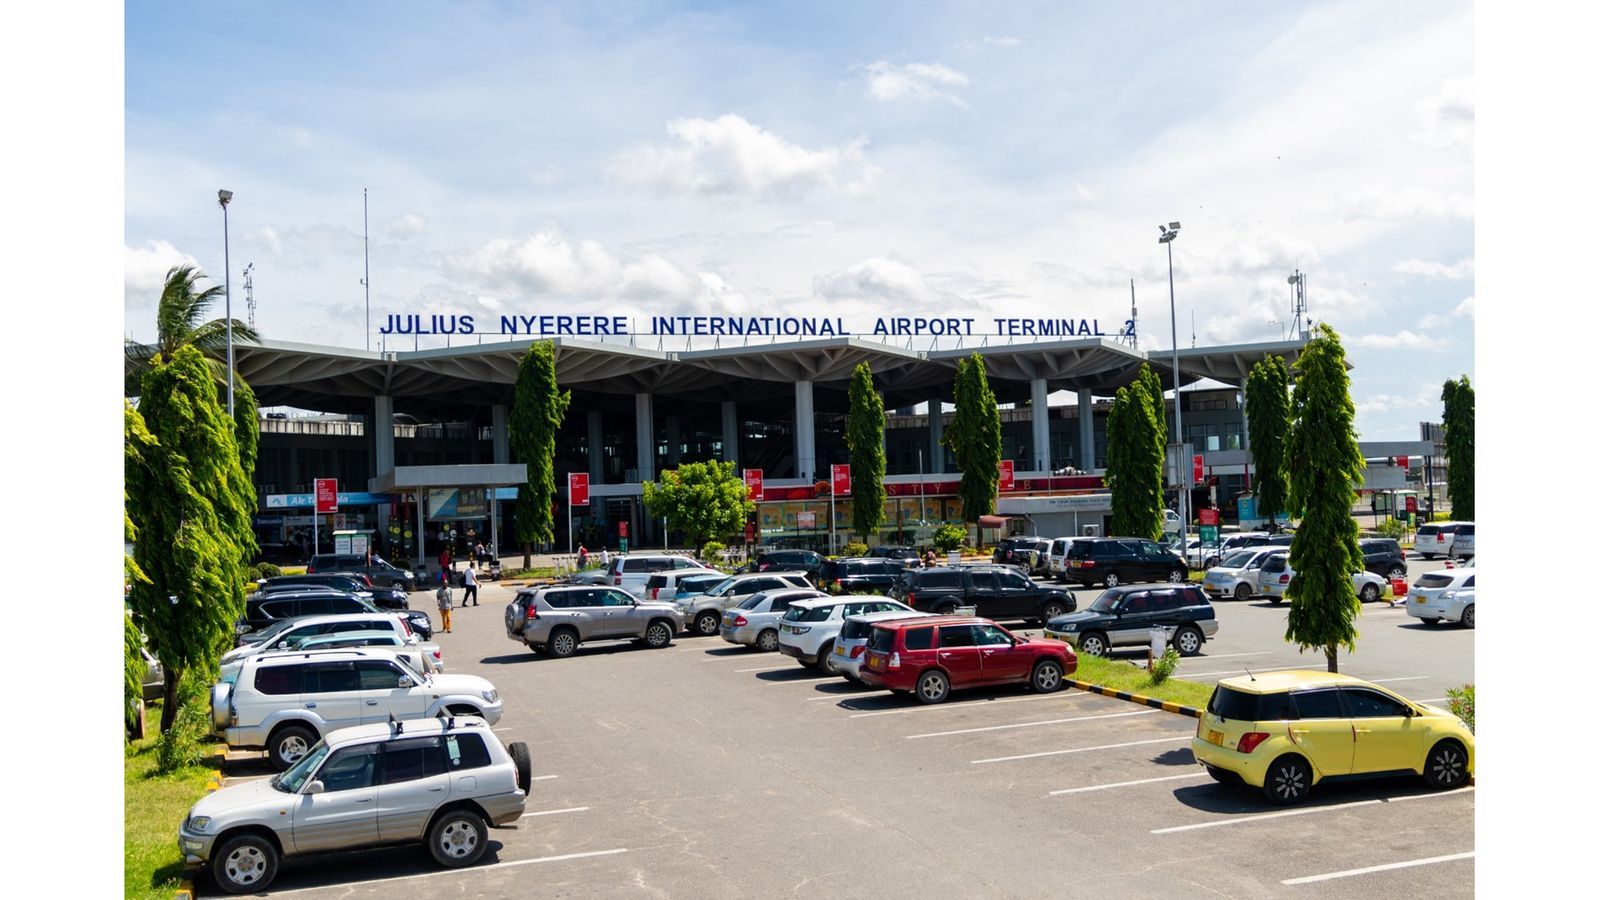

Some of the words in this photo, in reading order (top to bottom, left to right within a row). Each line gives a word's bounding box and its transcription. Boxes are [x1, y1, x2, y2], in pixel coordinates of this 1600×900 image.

[380, 315, 475, 335] JULIUS
[500, 316, 628, 336] NYERERE
[652, 316, 850, 336] INTERNATIONAL
[873, 318, 975, 336] AIRPORT
[995, 319, 1106, 336] TERMINAL
[1125, 319, 1136, 336] 2
[291, 497, 305, 505] Air
